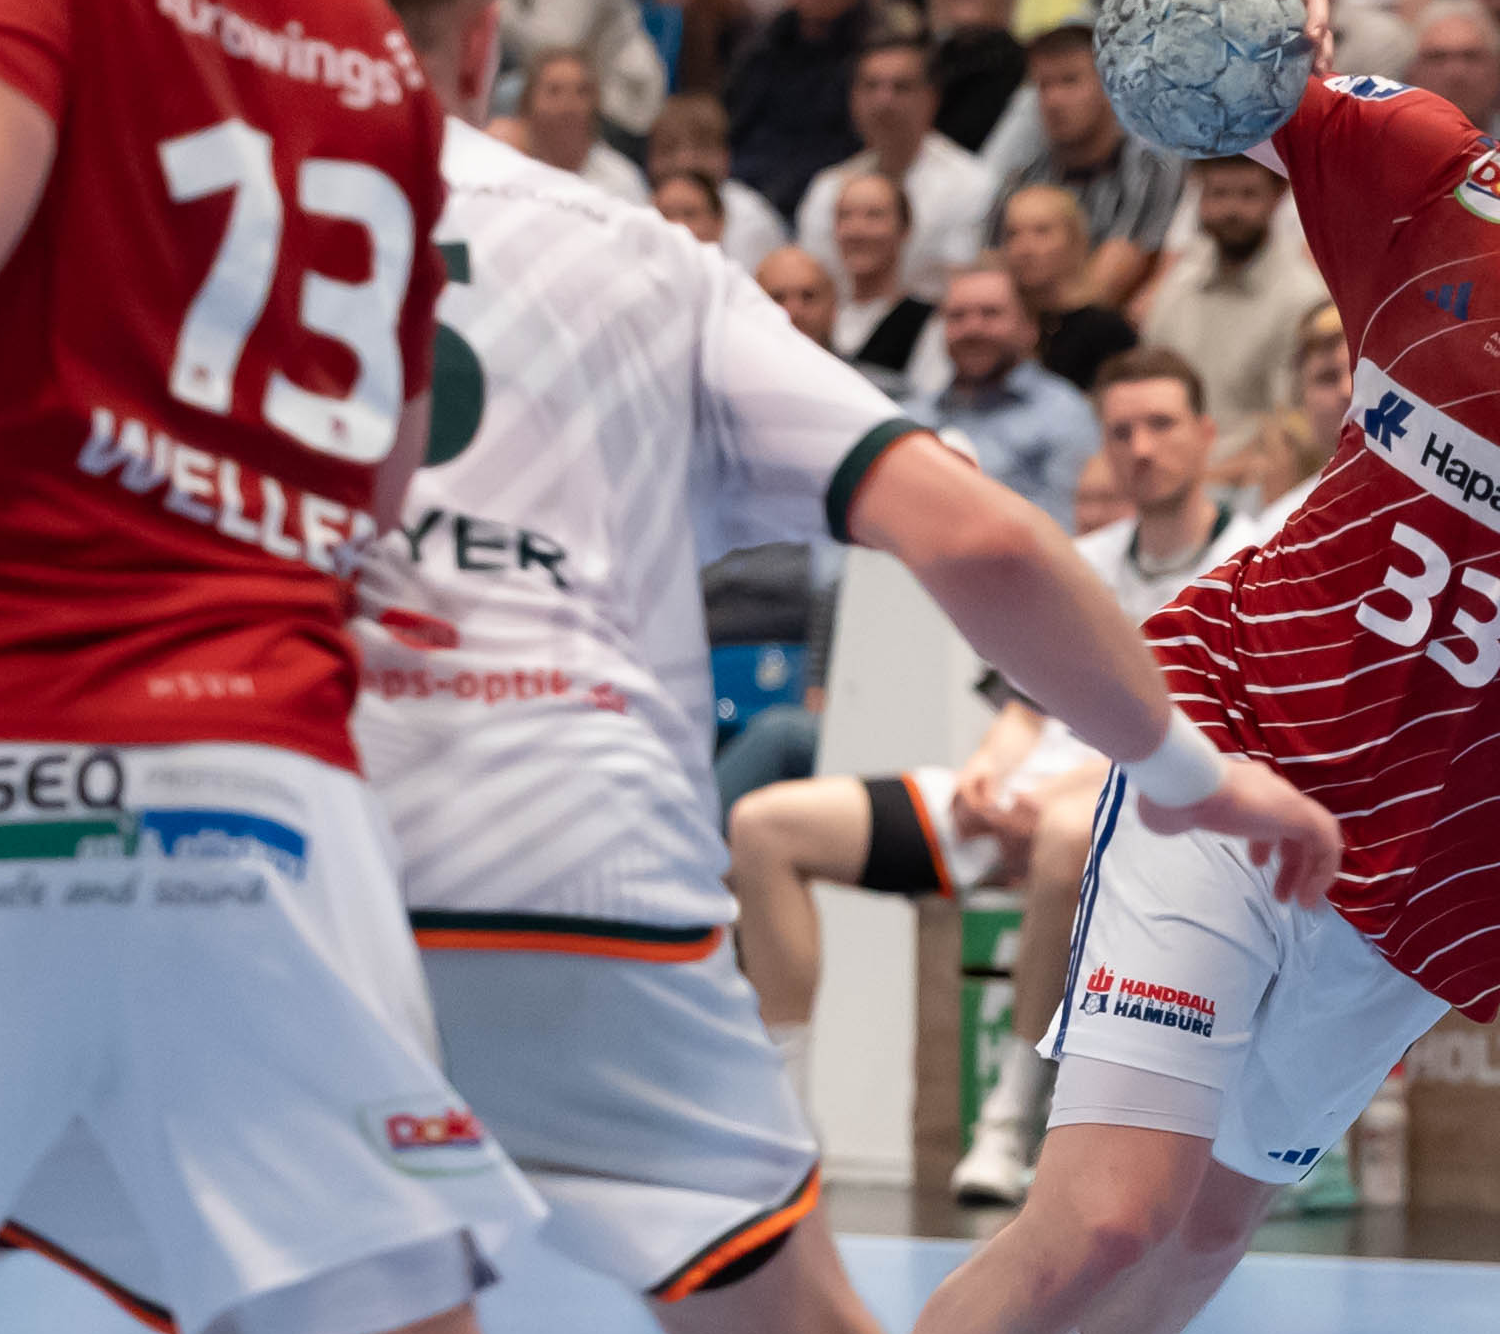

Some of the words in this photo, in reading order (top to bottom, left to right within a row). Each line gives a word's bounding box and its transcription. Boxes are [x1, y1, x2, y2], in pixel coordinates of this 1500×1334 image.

[156, 116, 416, 464] 73
[1119, 977, 1217, 1016] HANDBALL
[1112, 1000, 1214, 1038] HAMBURG
